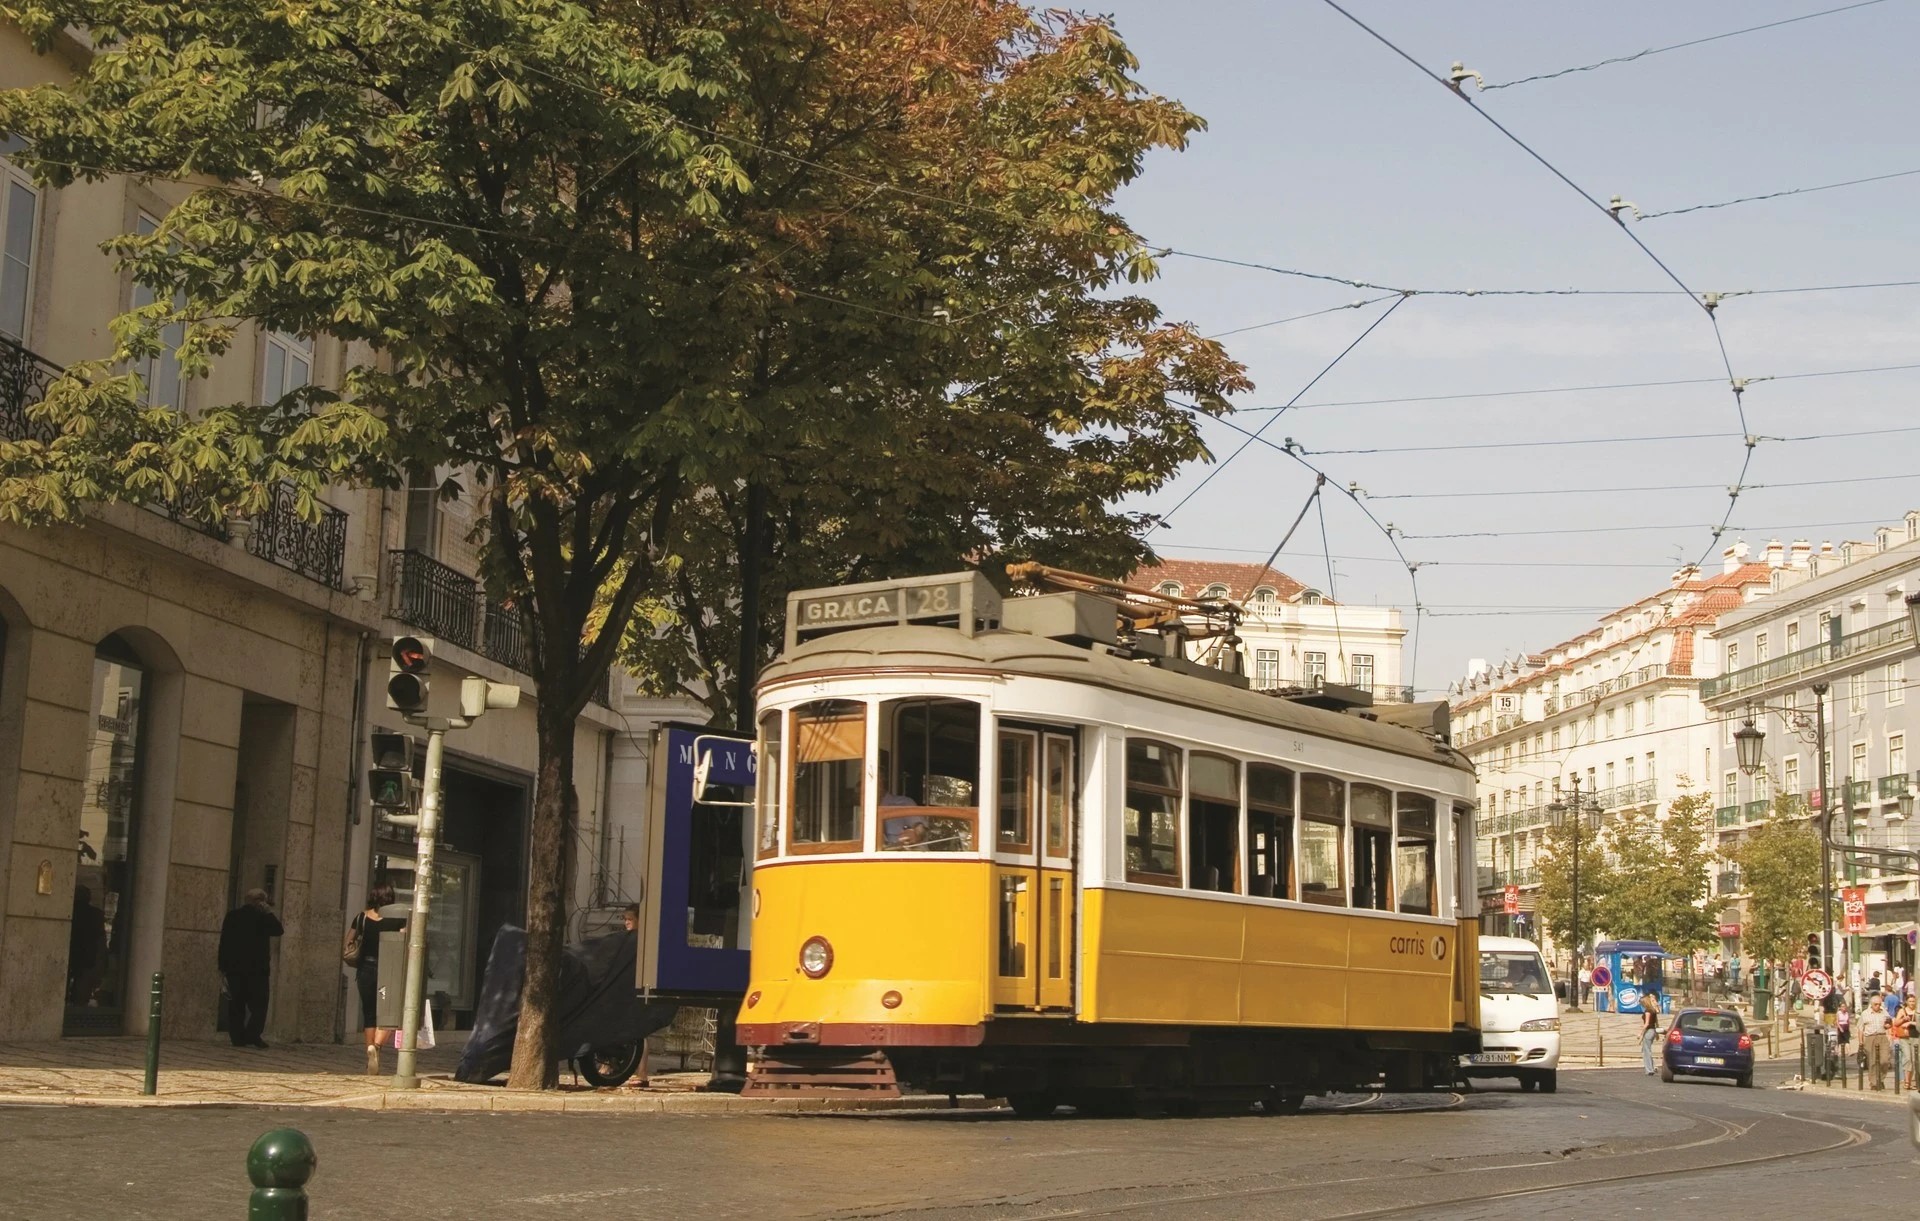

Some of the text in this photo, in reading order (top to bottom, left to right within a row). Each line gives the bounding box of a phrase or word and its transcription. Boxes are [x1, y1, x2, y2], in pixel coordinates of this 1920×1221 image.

[917, 586, 949, 613] 28
[1500, 697, 1511, 707] 15
[1293, 740, 1304, 752] 541
[1390, 930, 1425, 956] carris
